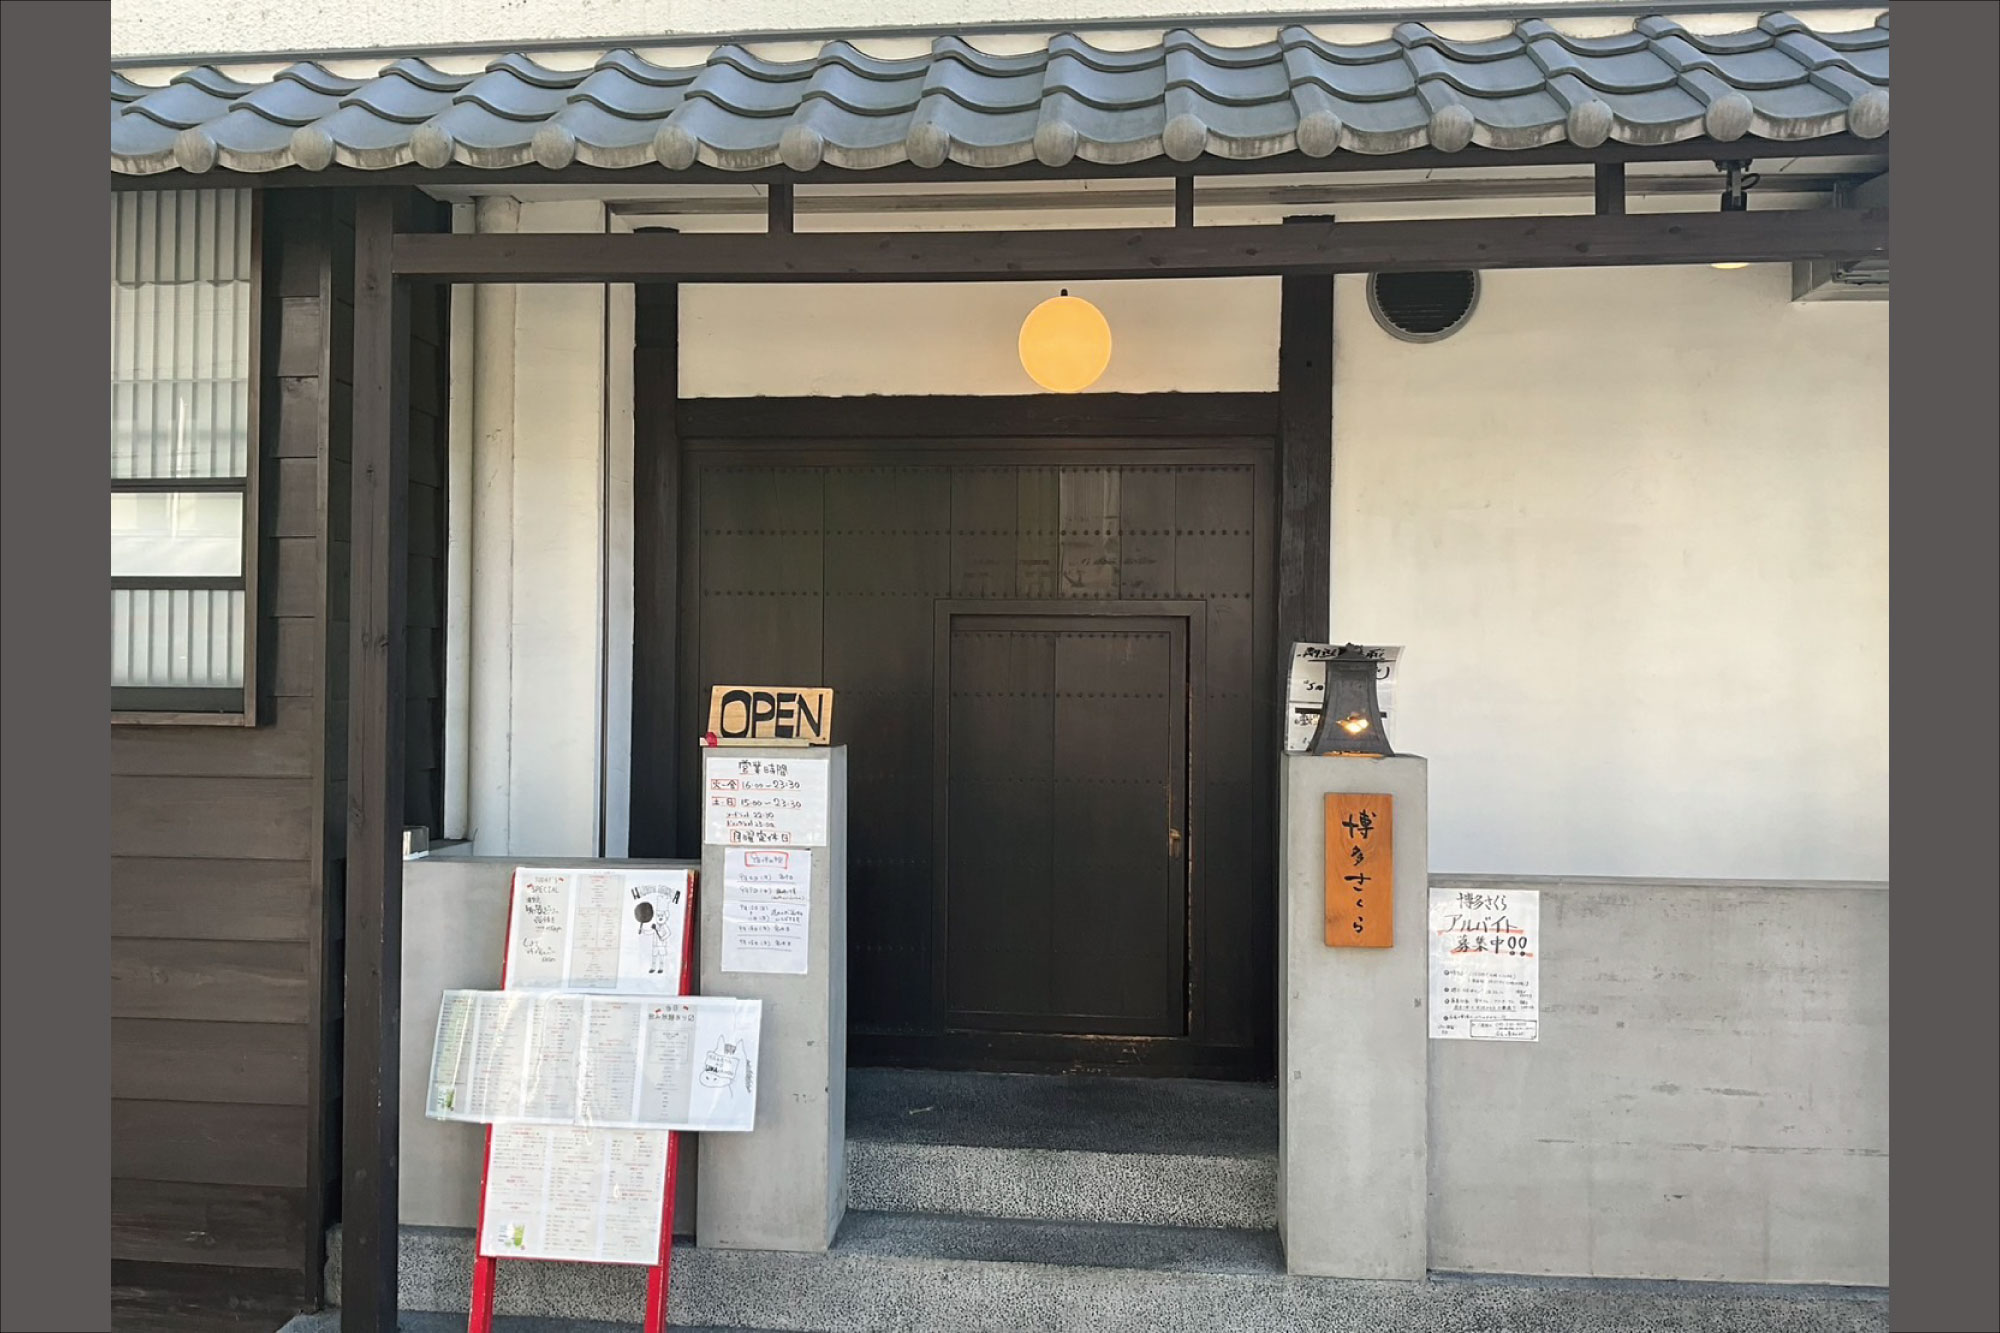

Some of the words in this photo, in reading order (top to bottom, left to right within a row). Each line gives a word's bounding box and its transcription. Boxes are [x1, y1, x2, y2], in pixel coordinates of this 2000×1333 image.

[720, 690, 823, 738] OPEN
[738, 760, 788, 777] 営業時間
[733, 830, 790, 843] 月曜定休日
[1342, 811, 1377, 933] 博多さくら
[1456, 892, 1507, 911] 博多さくら
[1444, 914, 1518, 933] アルバイト
